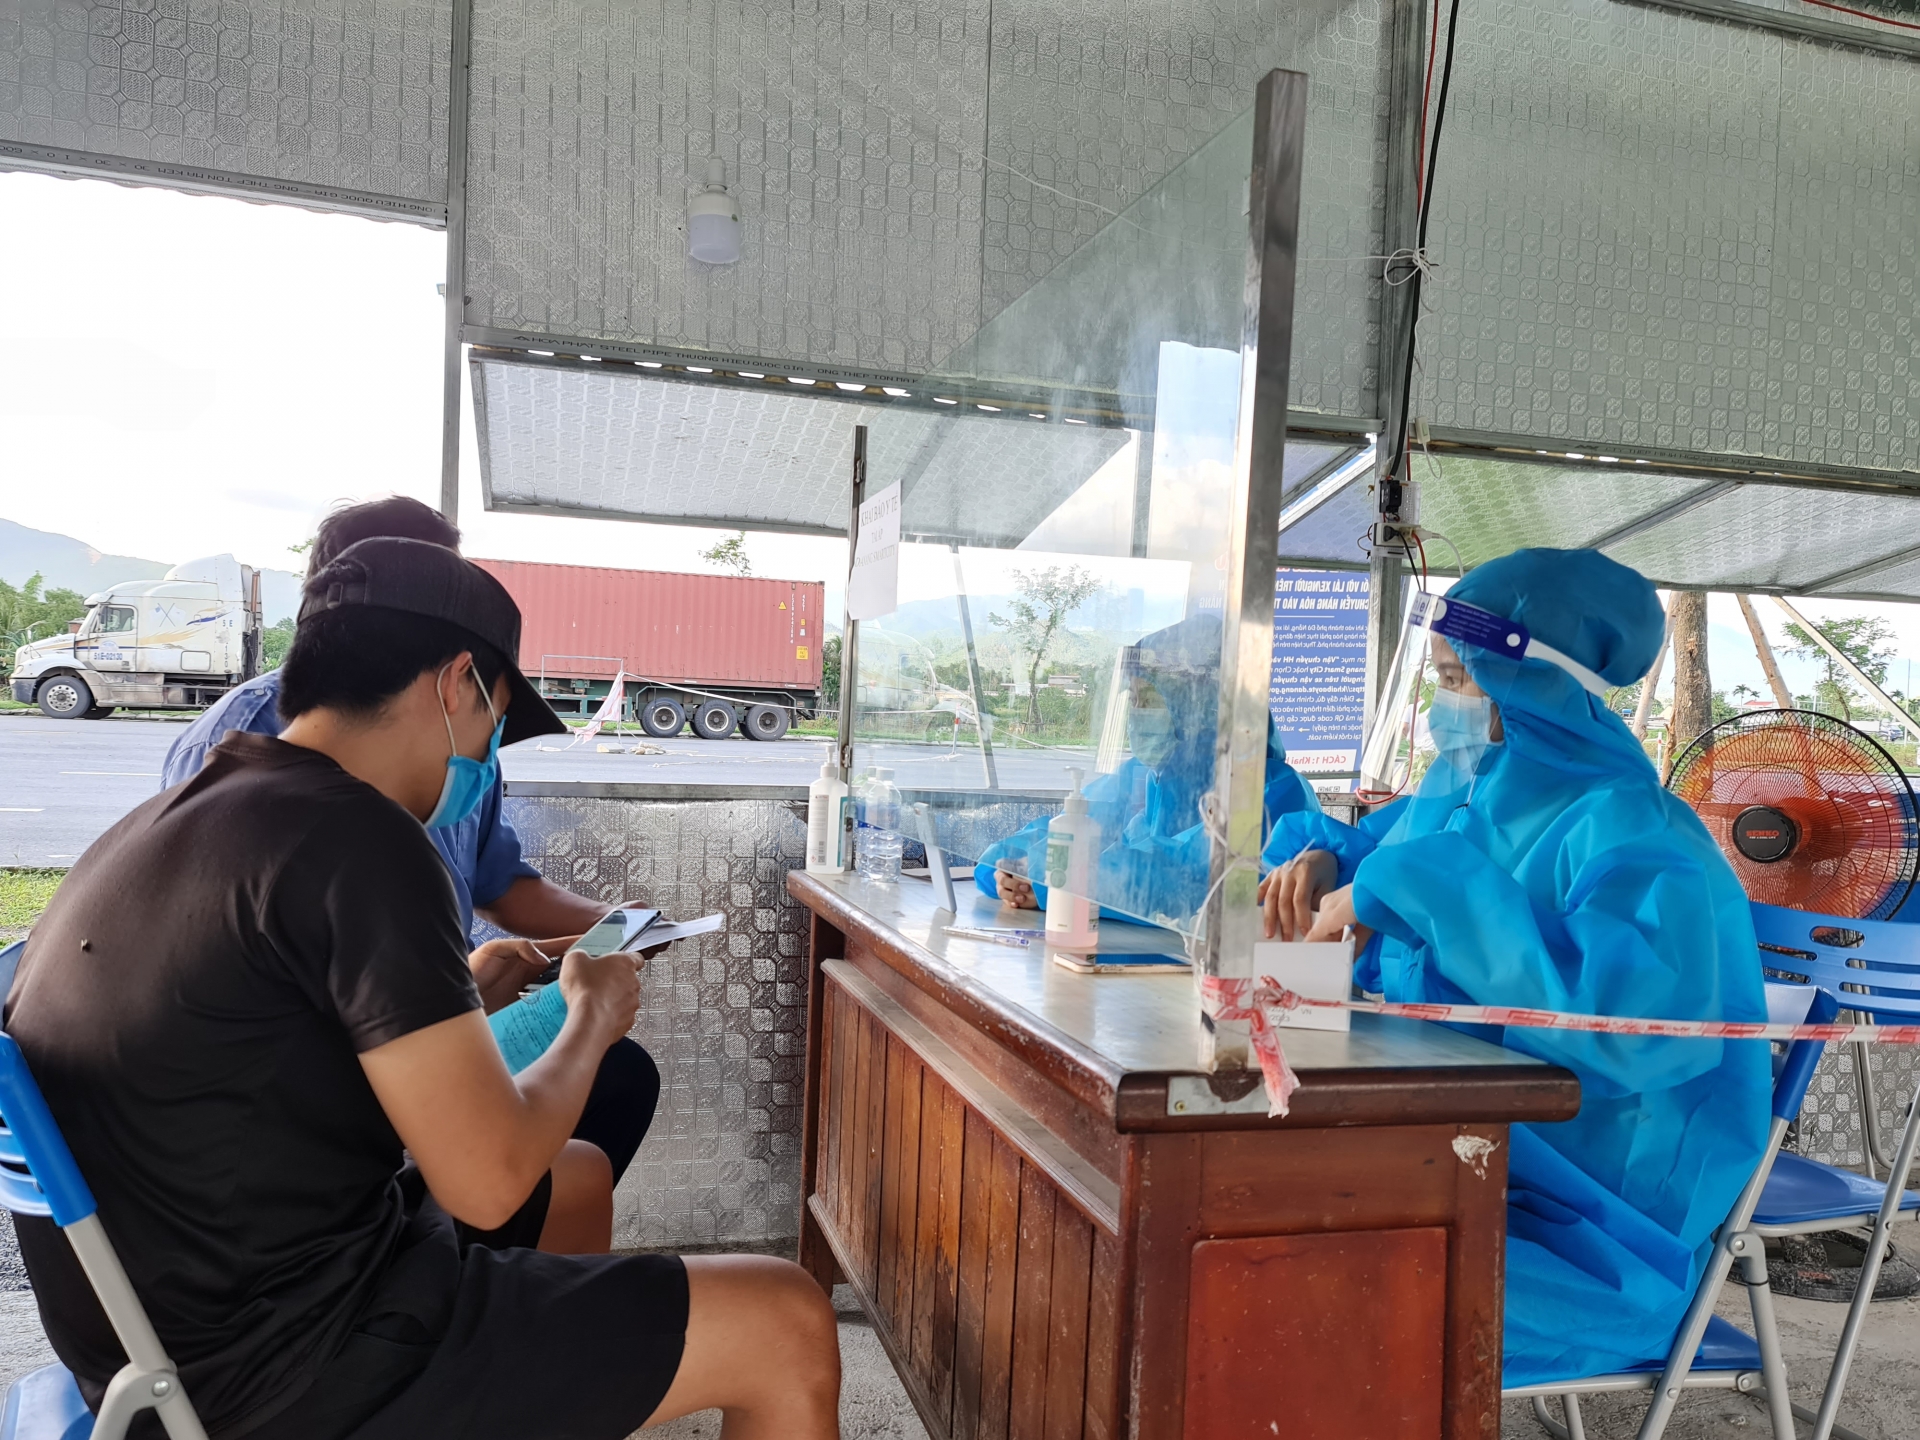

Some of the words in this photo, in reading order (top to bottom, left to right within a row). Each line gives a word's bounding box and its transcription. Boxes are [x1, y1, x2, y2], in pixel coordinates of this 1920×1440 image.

[157, 167, 183, 176] KEM
[206, 174, 232, 183] TON
[236, 179, 268, 188] THEP
[273, 184, 299, 192] ONG
[314, 189, 338, 198] GIA
[340, 193, 373, 203] QUOC
[375, 199, 408, 208] HIEU
[531, 337, 560, 345] HOA
[562, 340, 596, 348] PHAT
[600, 344, 638, 354] STEEL
[643, 349, 672, 357] PIPE
[676, 353, 719, 362] THUONG
[722, 358, 750, 366] HIEU
[752, 361, 781, 369] QUOC
[783, 364, 804, 372] GIA
[817, 368, 839, 376] ONG
[842, 371, 871, 379] THEP
[874, 374, 894, 382] TON
